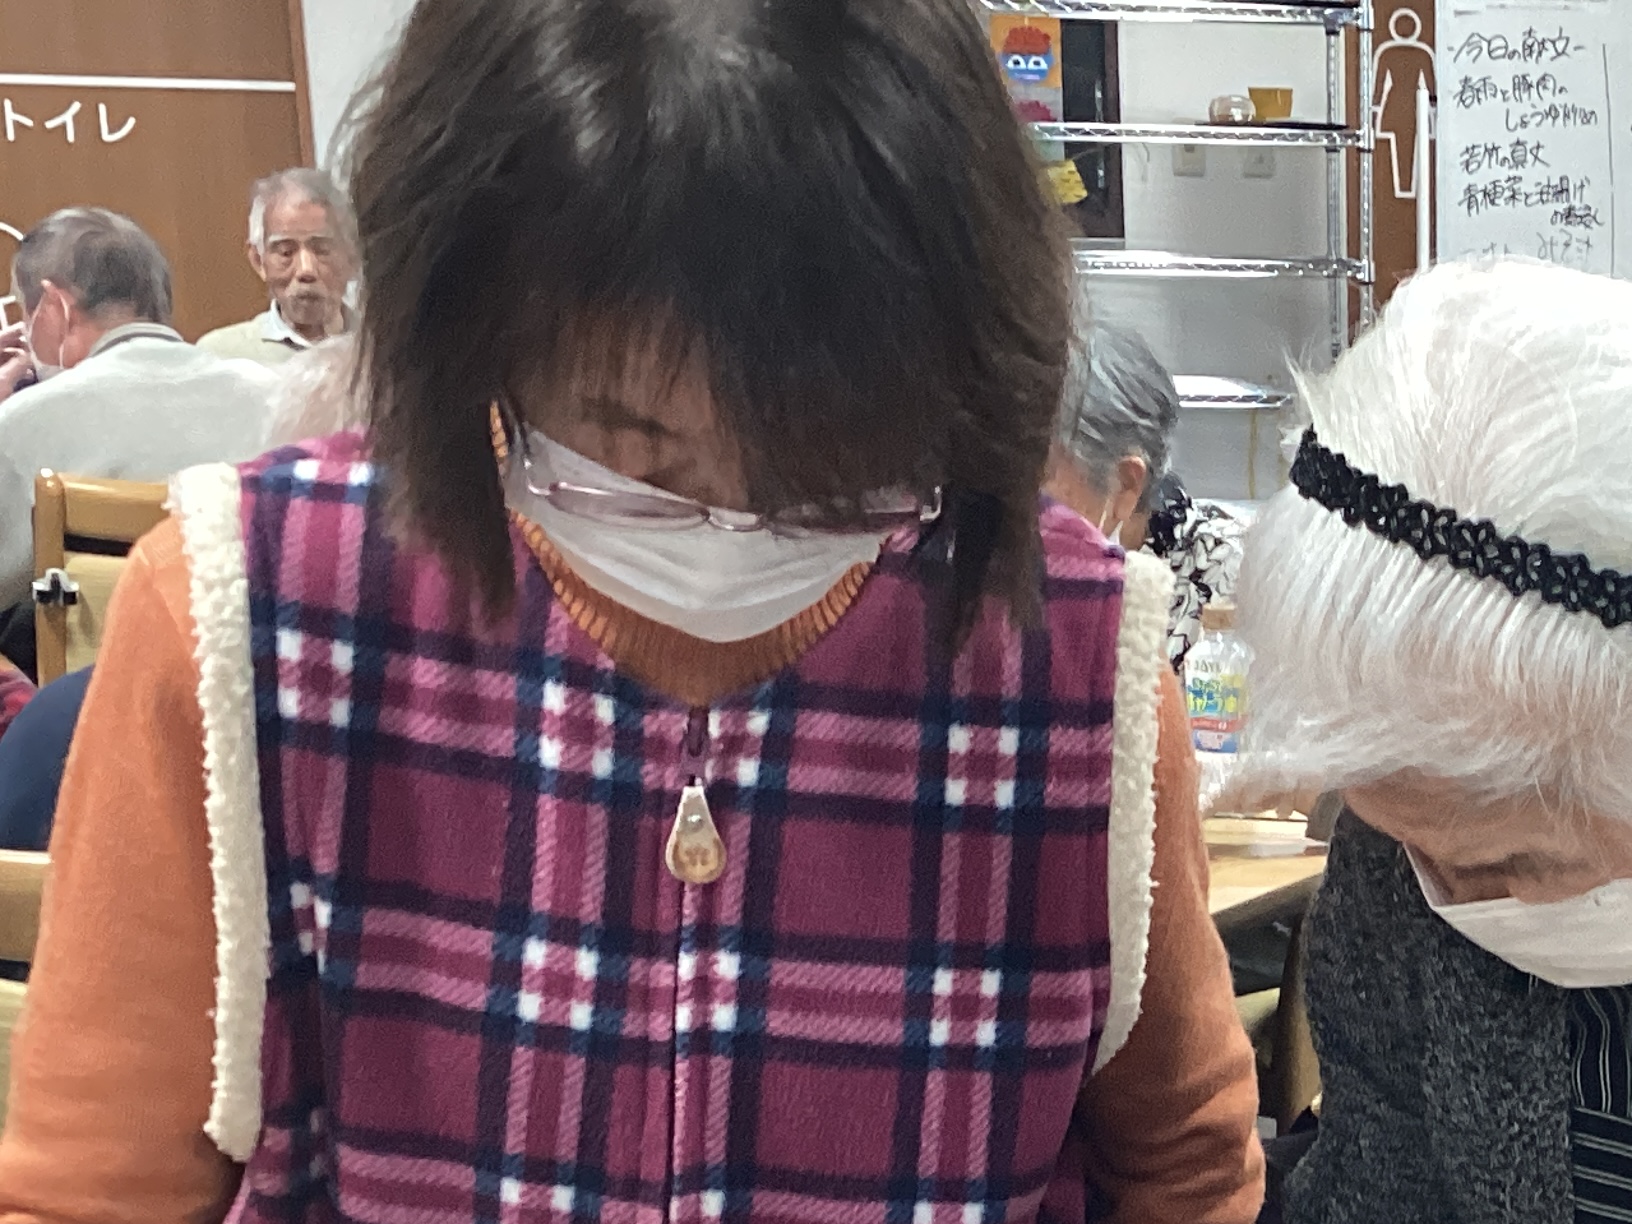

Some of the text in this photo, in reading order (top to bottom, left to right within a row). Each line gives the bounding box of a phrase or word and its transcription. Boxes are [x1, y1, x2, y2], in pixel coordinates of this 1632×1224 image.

[1453, 72, 1569, 109] 春雨と豚肉の
[3, 98, 136, 143] トイレ
[1459, 137, 1551, 175] 若竹の真丈
[1458, 175, 1591, 217] 青梗菜と油揚げ
